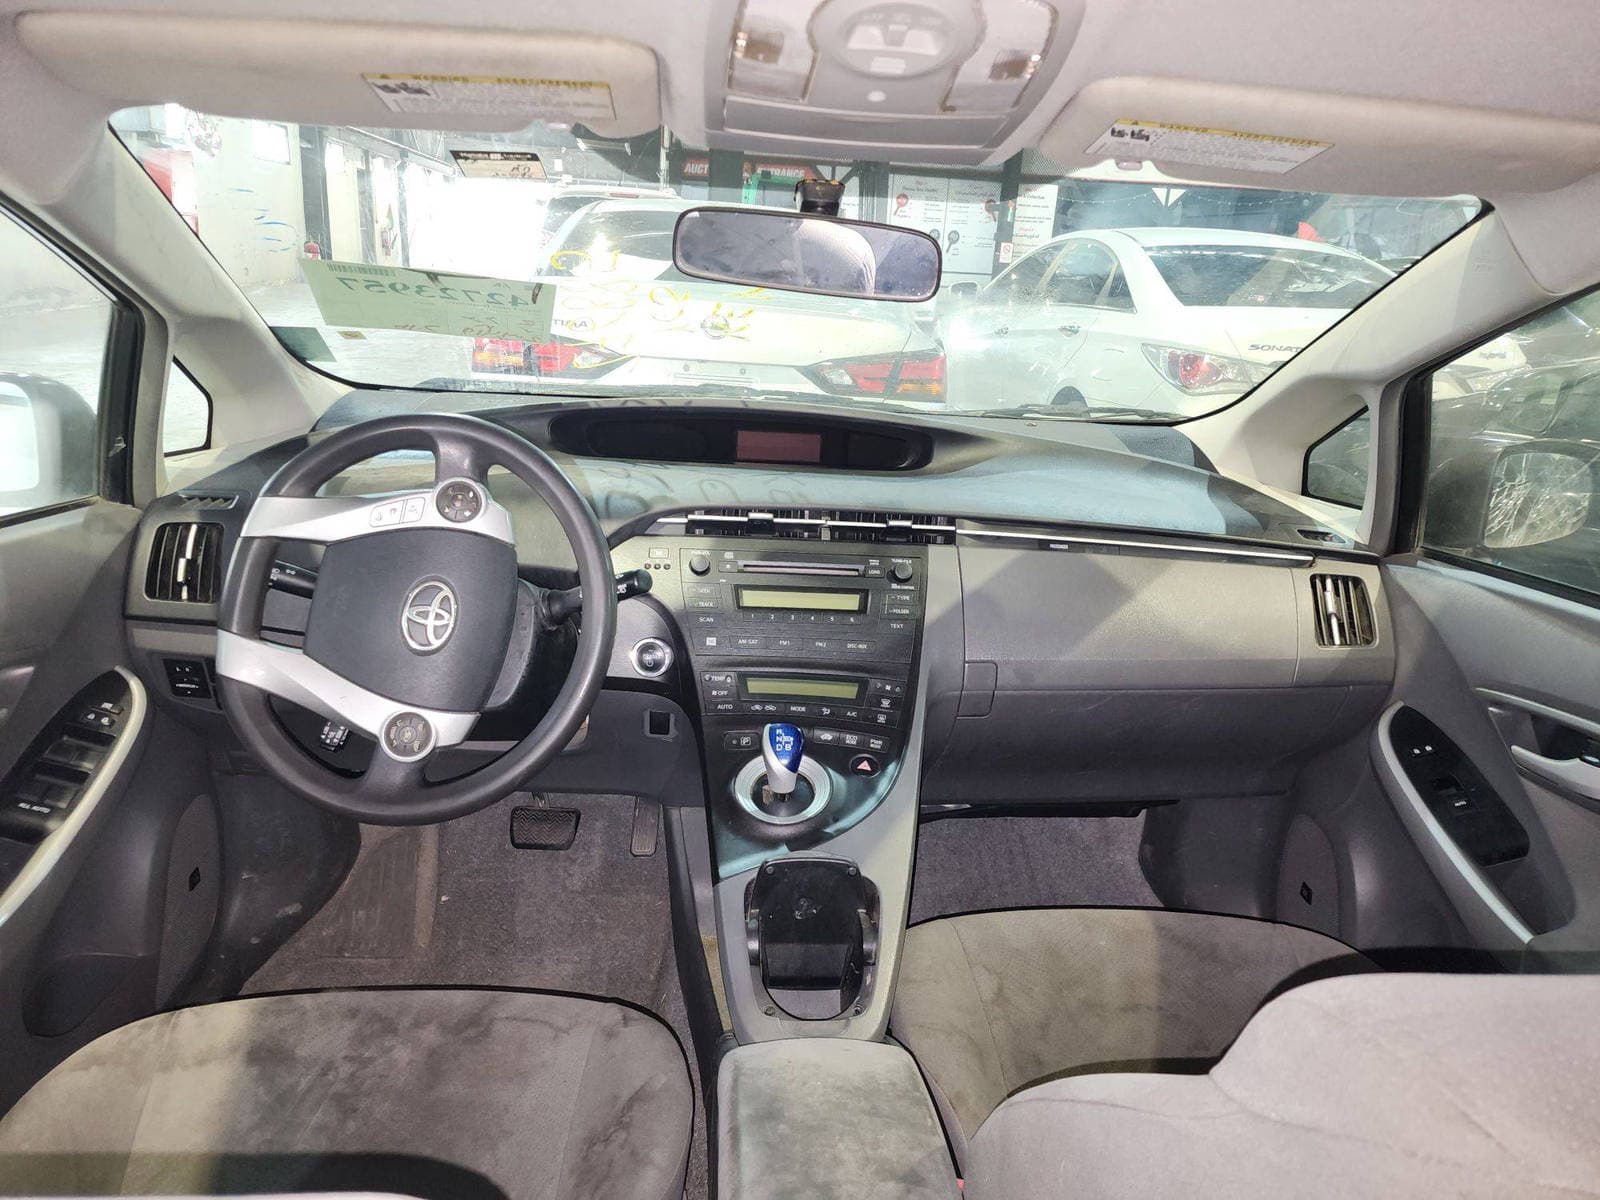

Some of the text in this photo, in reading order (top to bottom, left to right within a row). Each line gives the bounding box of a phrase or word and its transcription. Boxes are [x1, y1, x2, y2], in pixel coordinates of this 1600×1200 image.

[684, 163, 805, 178] AUCT ETRANCE
[1248, 344, 1304, 353] SONAT
[776, 743, 792, 751] D B
